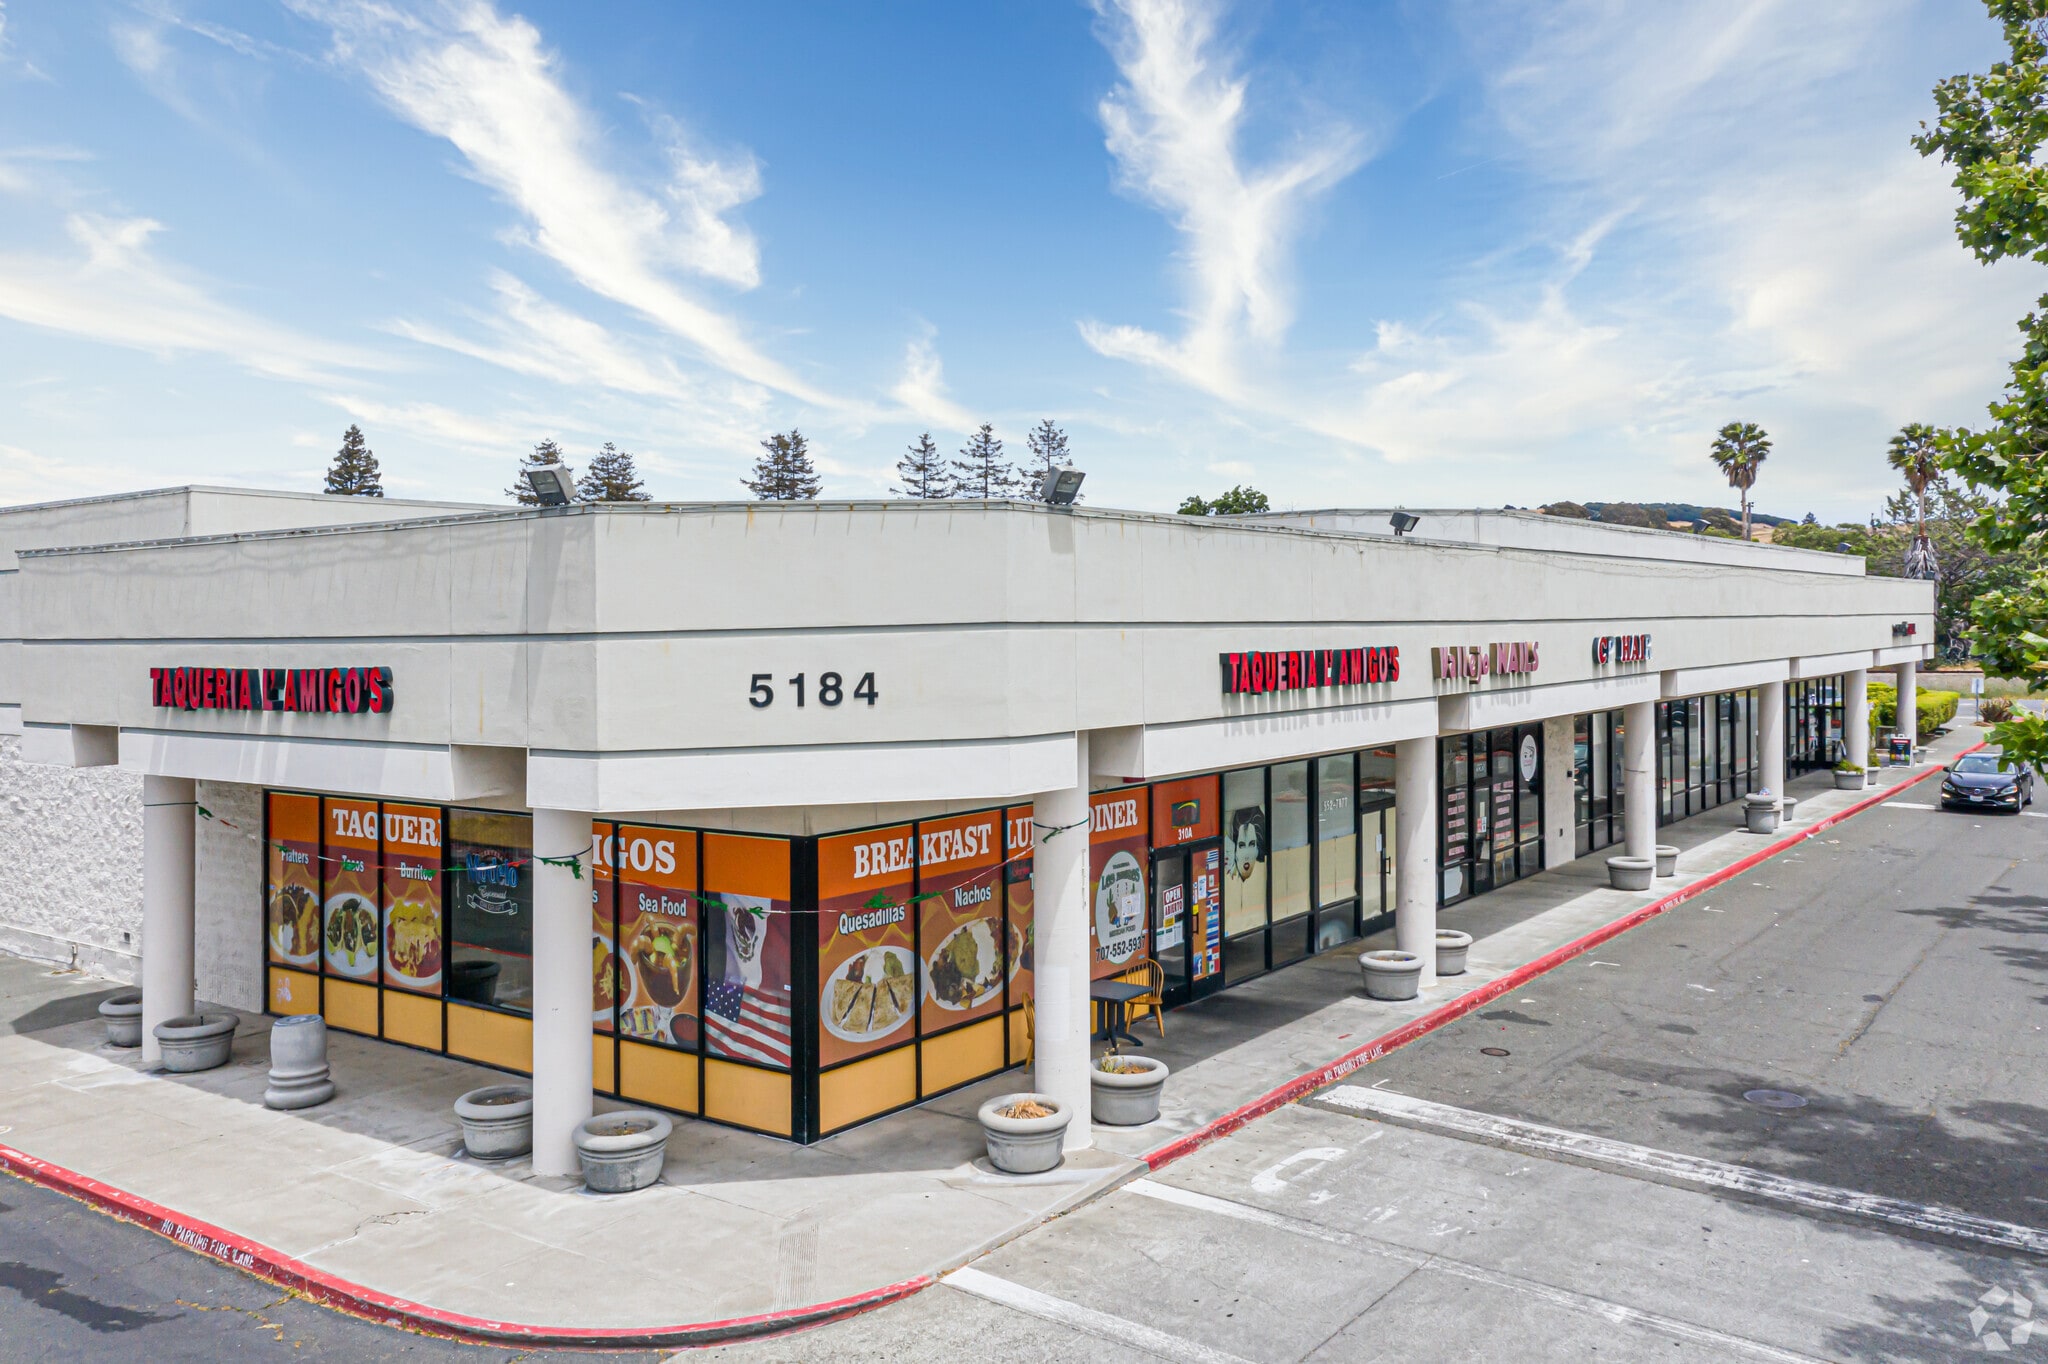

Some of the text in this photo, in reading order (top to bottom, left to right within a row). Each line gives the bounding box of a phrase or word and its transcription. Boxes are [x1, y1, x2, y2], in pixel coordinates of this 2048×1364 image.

[1494, 641, 1539, 674] NAILS
[1620, 633, 1653, 662] HAIR
[1221, 650, 1317, 695] TAQUERIA
[150, 666, 256, 711] TAQUERIA
[748, 671, 879, 709] 5184
[1178, 826, 1192, 841] 310A
[281, 849, 309, 865] Platters
[341, 854, 364, 872] Tos
[853, 823, 992, 879] BREAKFAST
[466, 852, 518, 888] Modelo
[639, 892, 687, 917] Sea Food
[954, 885, 991, 908] Nachos
[1165, 888, 1181, 903] OPEN
[839, 905, 905, 935] Quesadillas
[1096, 935, 1145, 962] 707-552-5937
[160, 1218, 254, 1269] NO PARKING FIRE LANE
